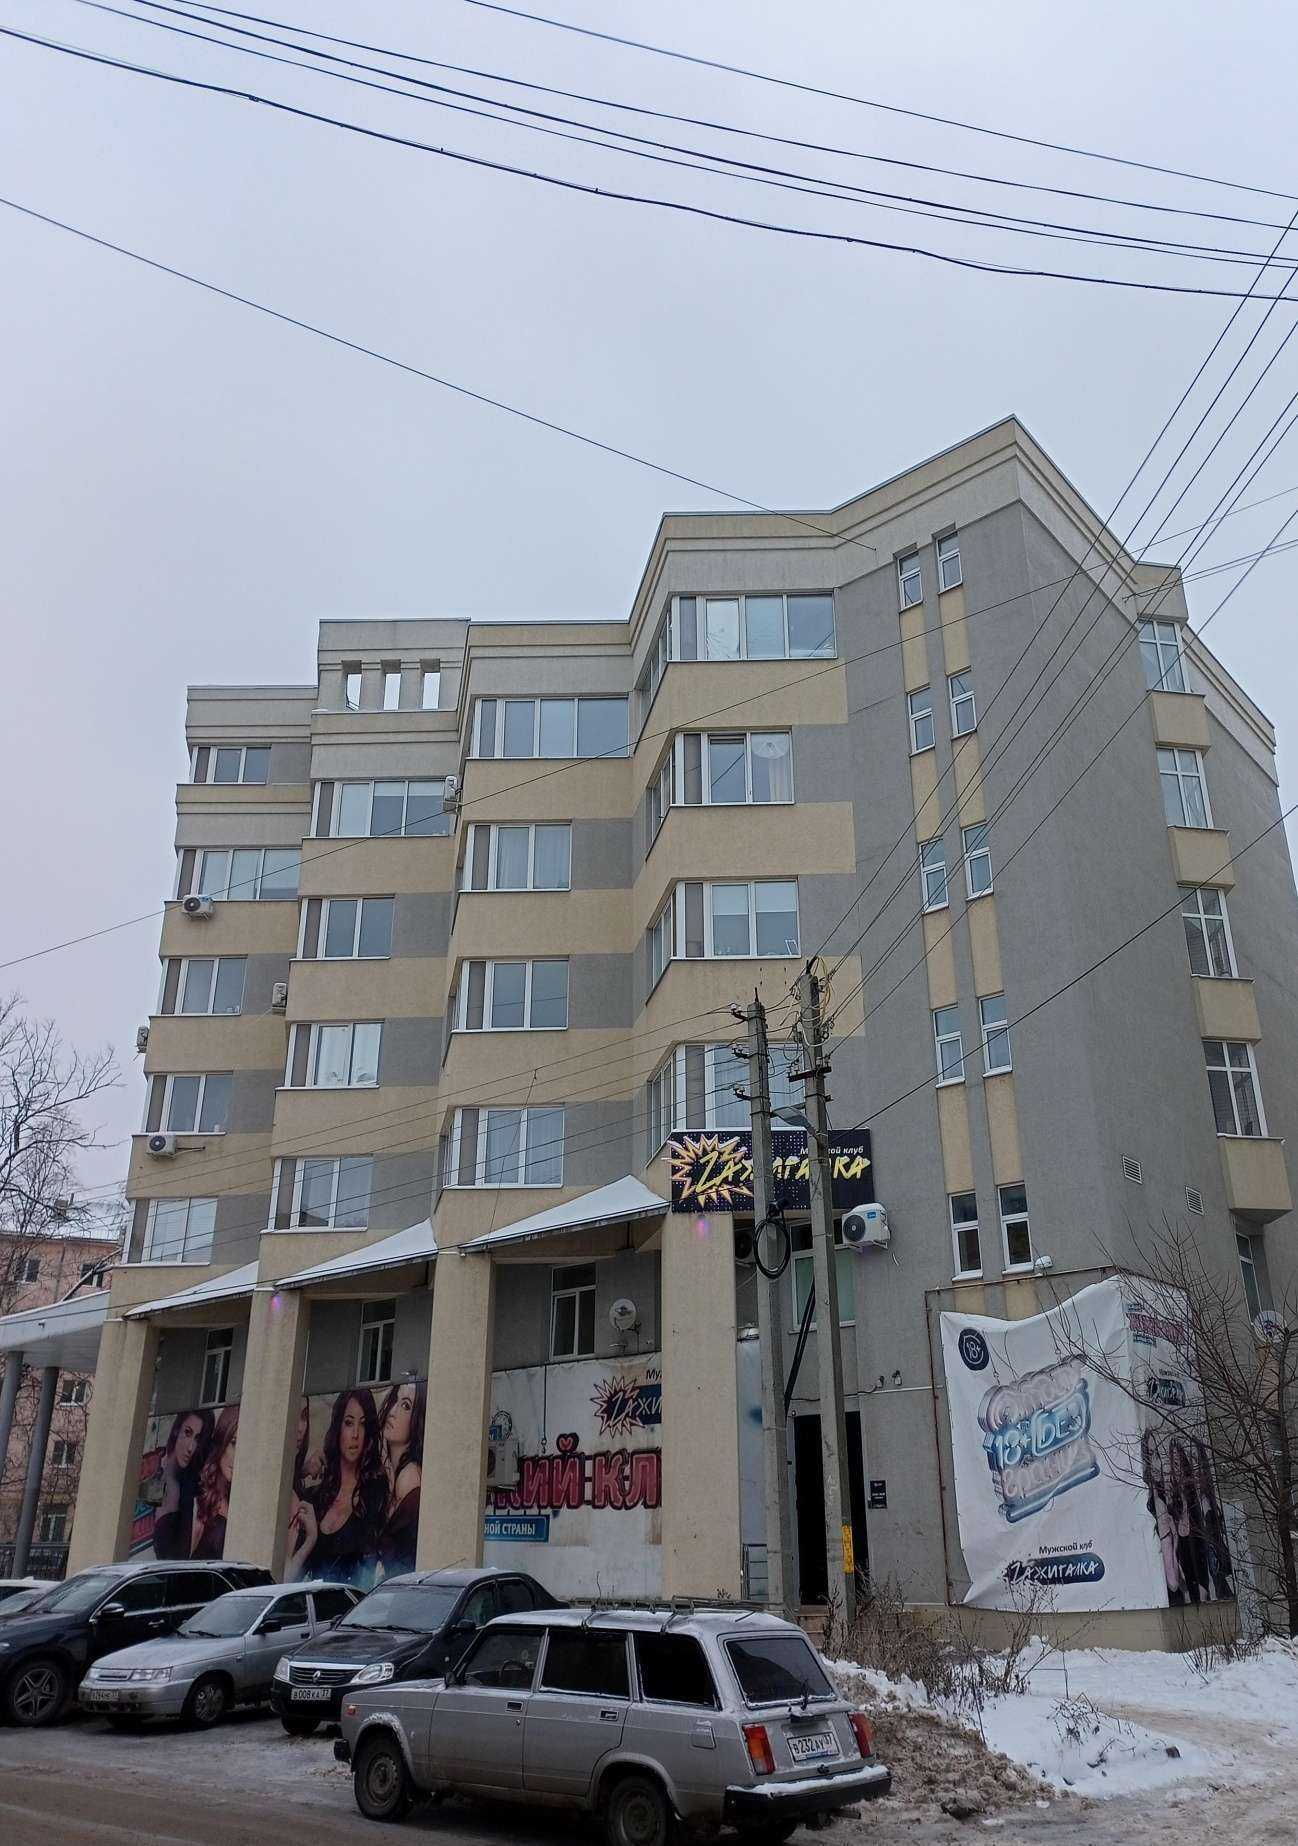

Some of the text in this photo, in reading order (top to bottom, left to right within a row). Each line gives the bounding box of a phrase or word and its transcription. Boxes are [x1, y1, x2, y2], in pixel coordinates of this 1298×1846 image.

[843, 1145, 864, 1155] клуб
[646, 1368, 662, 1383] Му
[502, 1522, 536, 1536] СТРАНЫ
[1039, 1539, 1093, 1555] Мужской клуб
